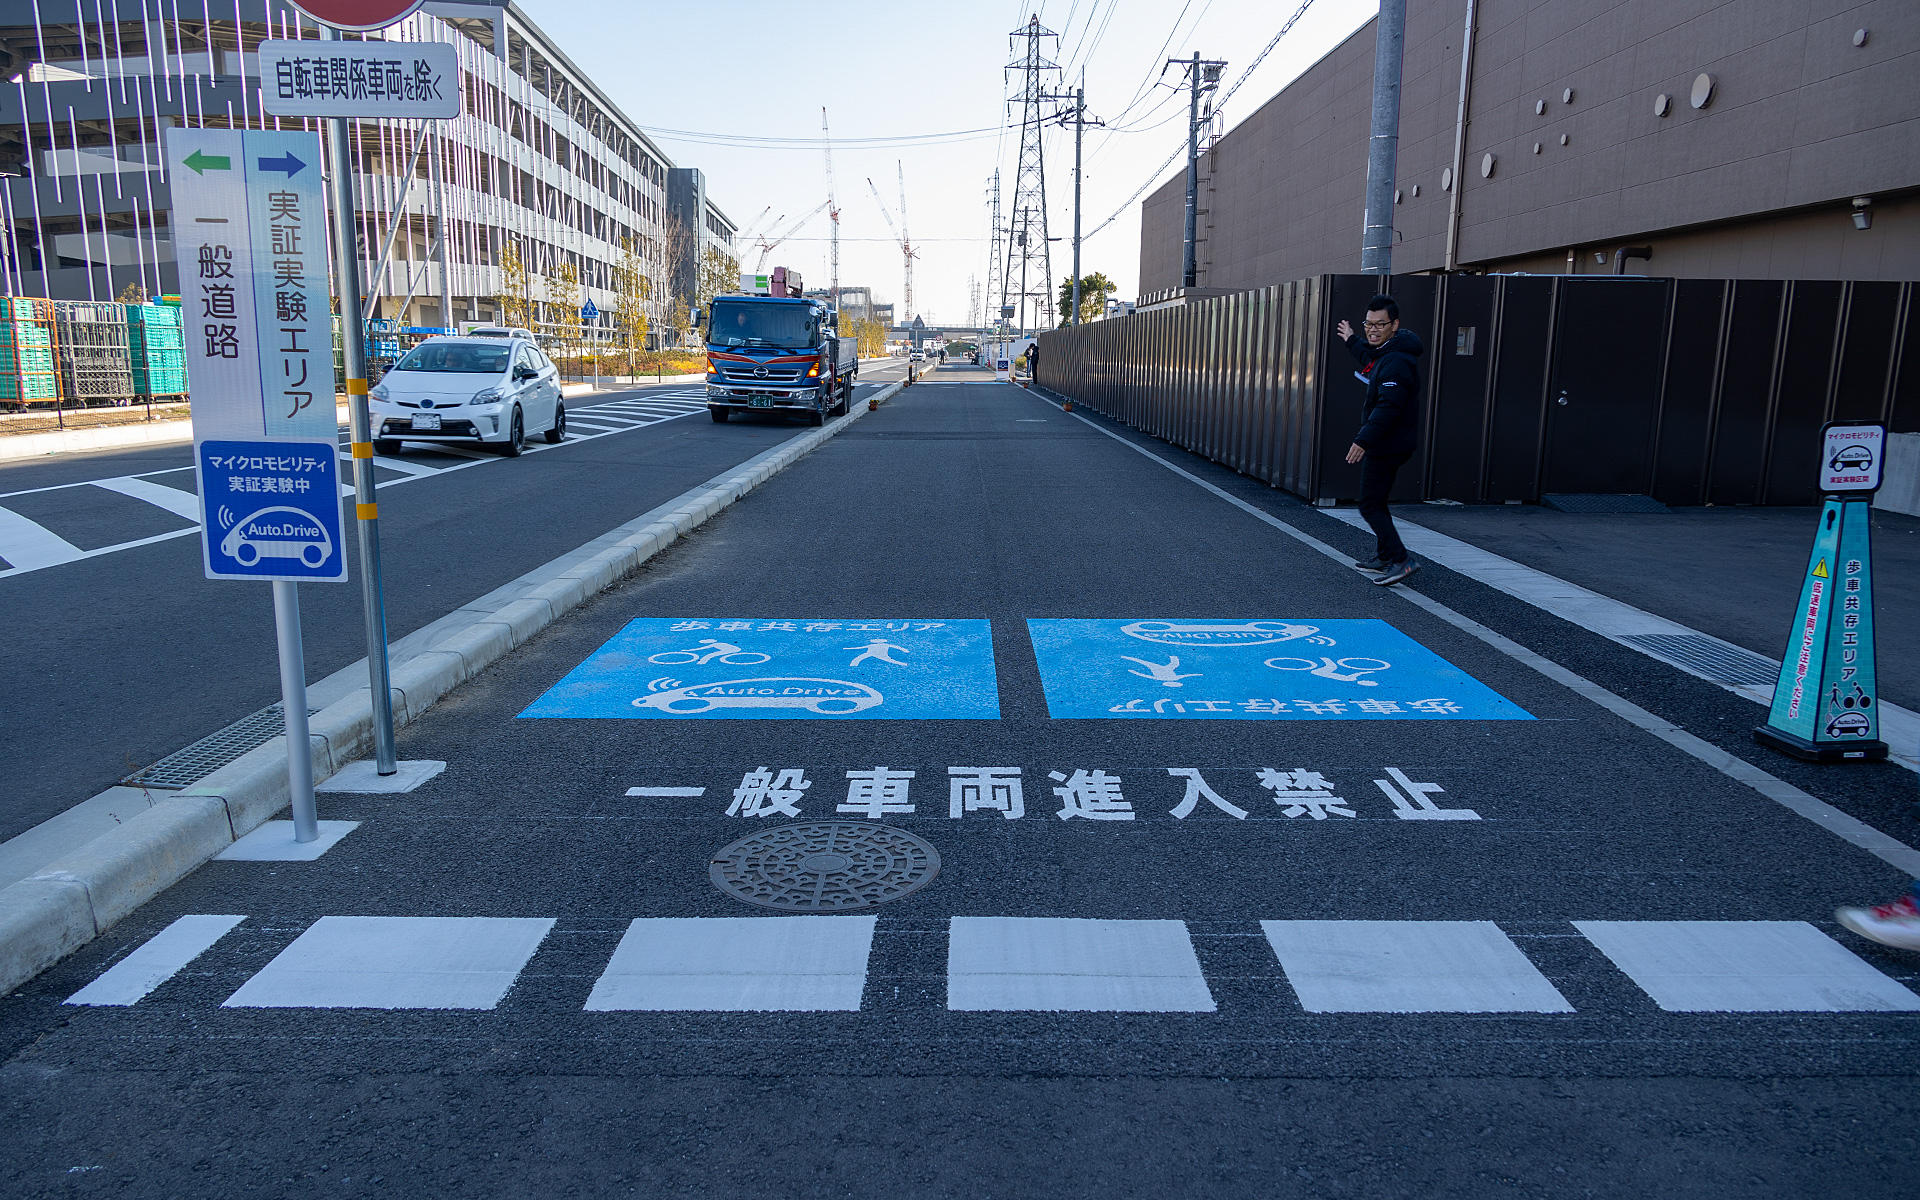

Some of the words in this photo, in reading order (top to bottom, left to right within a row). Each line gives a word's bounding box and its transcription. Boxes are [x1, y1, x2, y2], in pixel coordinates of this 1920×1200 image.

[276, 57, 442, 101] 自転車関係車両を除く
[195, 217, 239, 359] 一般道路
[268, 190, 313, 418] 実証実験エリア
[1828, 432, 1880, 440] マイクロモビリティ
[209, 455, 326, 473] マイクロモビリティ
[228, 475, 310, 494] 実証実験中
[1830, 475, 1870, 484] 実証実験区間
[248, 523, 320, 537] Auto.Drive
[670, 621, 946, 632] 歩車共存エリア
[1841, 560, 1861, 681] 歩車共存エリア
[1789, 580, 1822, 718] 低速車両にご注意ください
[703, 686, 862, 696] Auto.Drive
[1108, 698, 1463, 715] 歩車共存エリア
[625, 766, 1482, 820] 一般車両進入禁止
